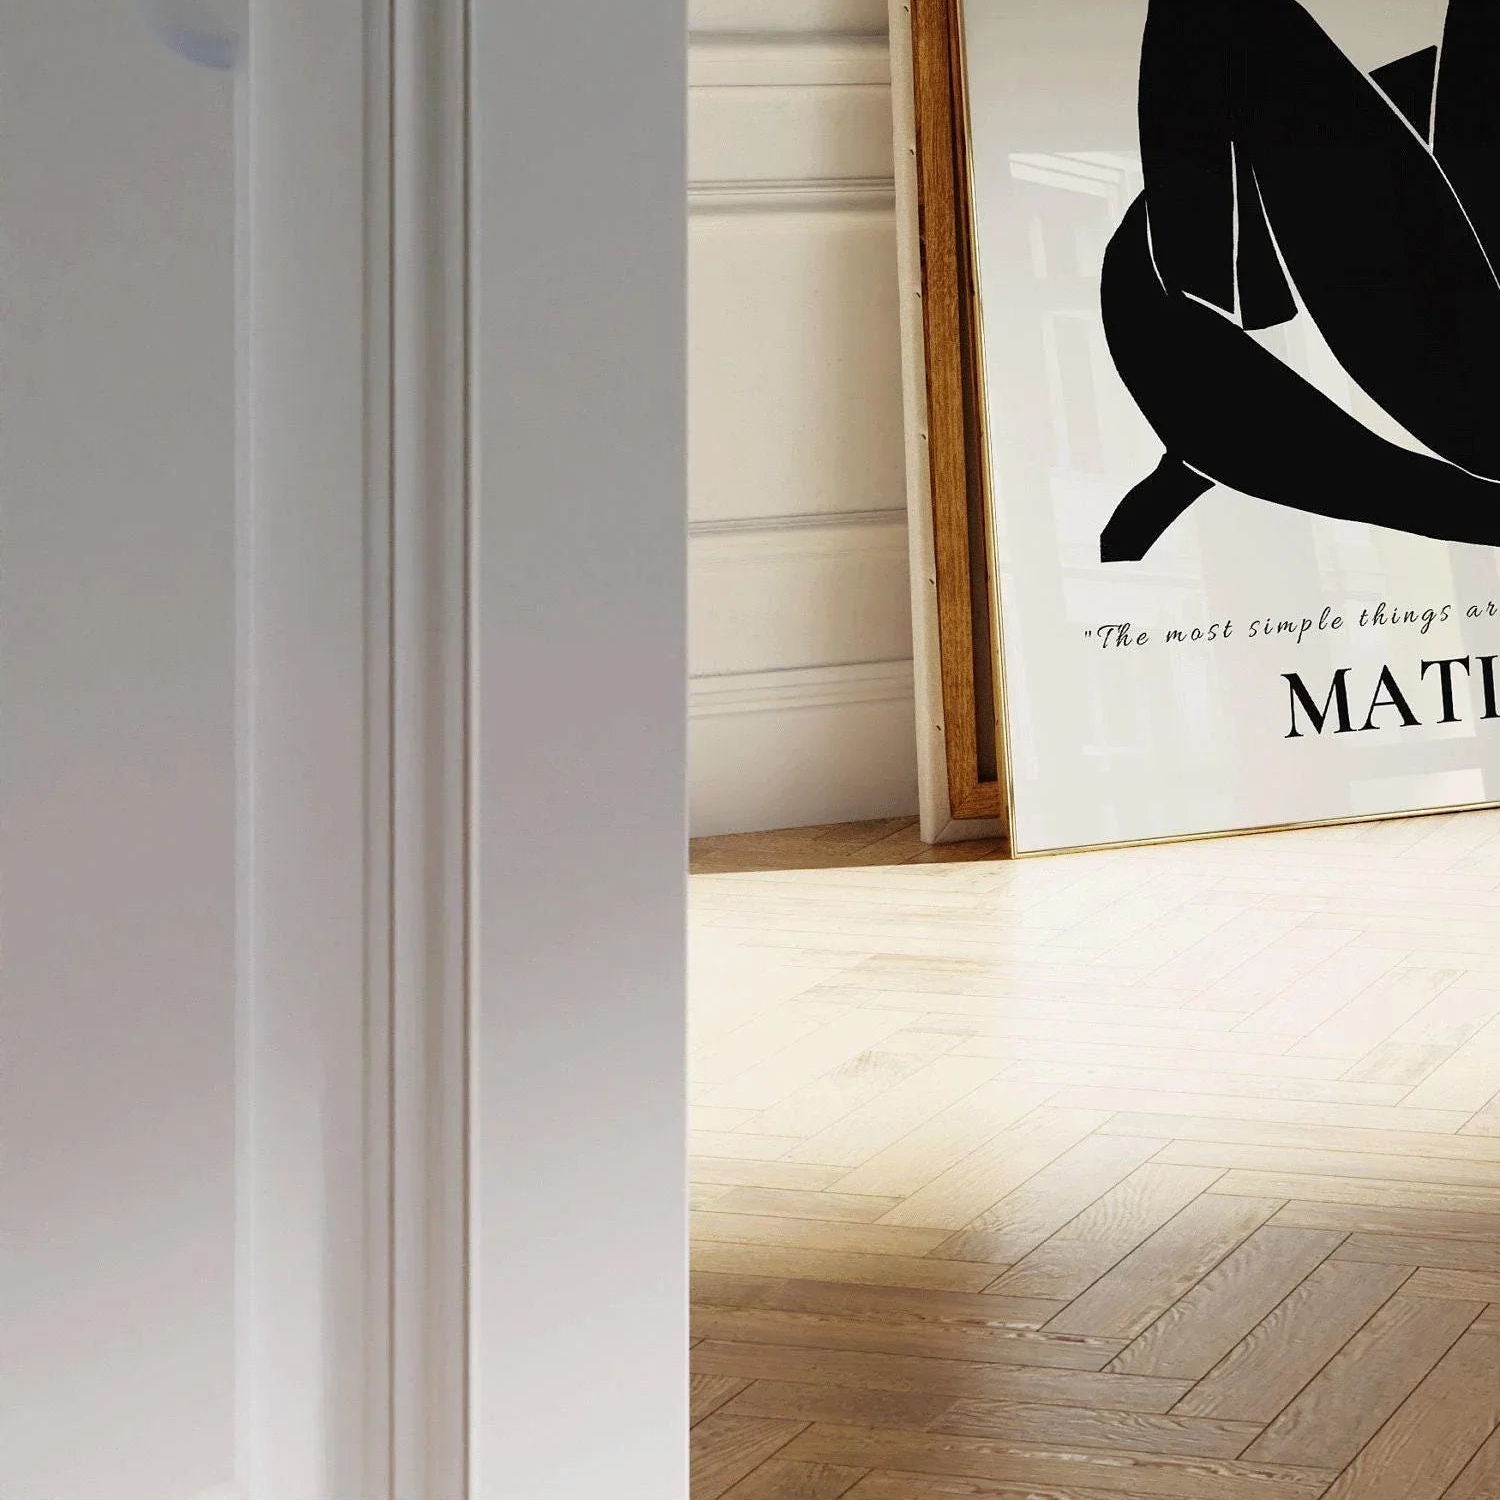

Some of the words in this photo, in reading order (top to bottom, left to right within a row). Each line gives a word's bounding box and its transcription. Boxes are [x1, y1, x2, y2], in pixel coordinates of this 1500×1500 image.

[1083, 621, 1150, 649] "The
[1165, 619, 1234, 644] most
[1247, 605, 1344, 645] simple
[1358, 601, 1453, 635] things
